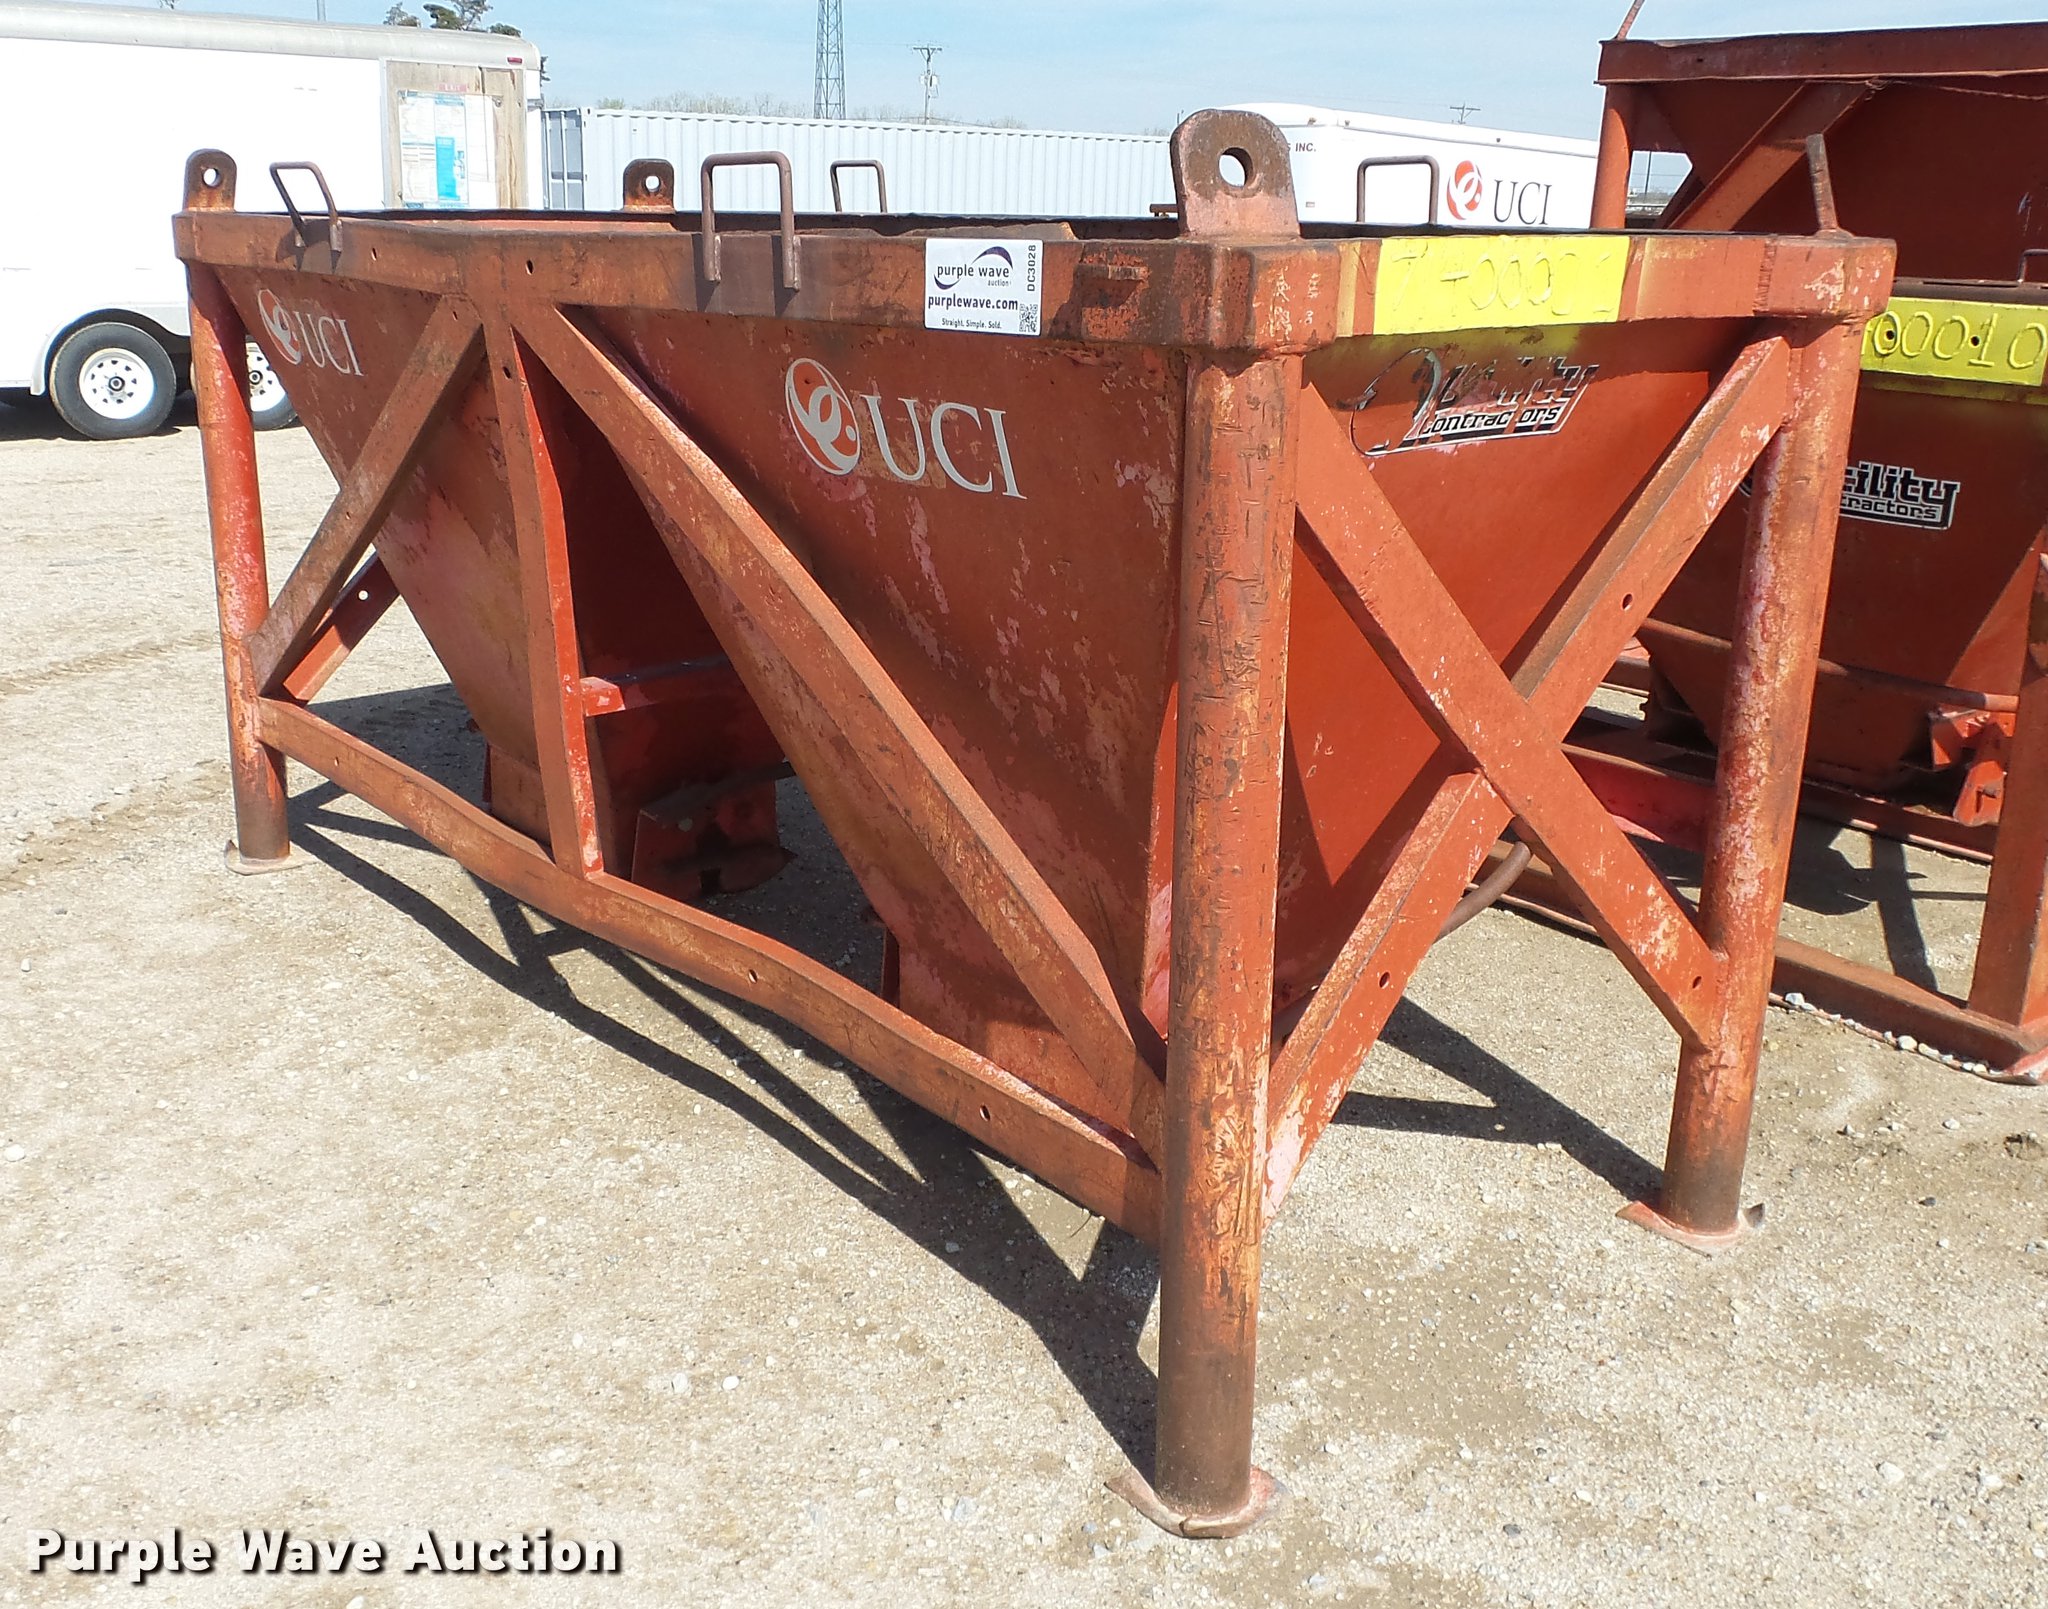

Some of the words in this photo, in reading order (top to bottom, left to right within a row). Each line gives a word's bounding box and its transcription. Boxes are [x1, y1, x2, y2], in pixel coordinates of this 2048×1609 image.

[1295, 142, 1317, 152] INC.
[1493, 180, 1553, 225] UCI
[937, 264, 974, 279] purple
[979, 267, 1010, 278] wave
[987, 279, 1009, 287] auction
[1027, 244, 1037, 292] DC3028
[928, 294, 1018, 311] purplewave.com
[292, 310, 365, 377] UCI
[860, 393, 1028, 500] UCI
